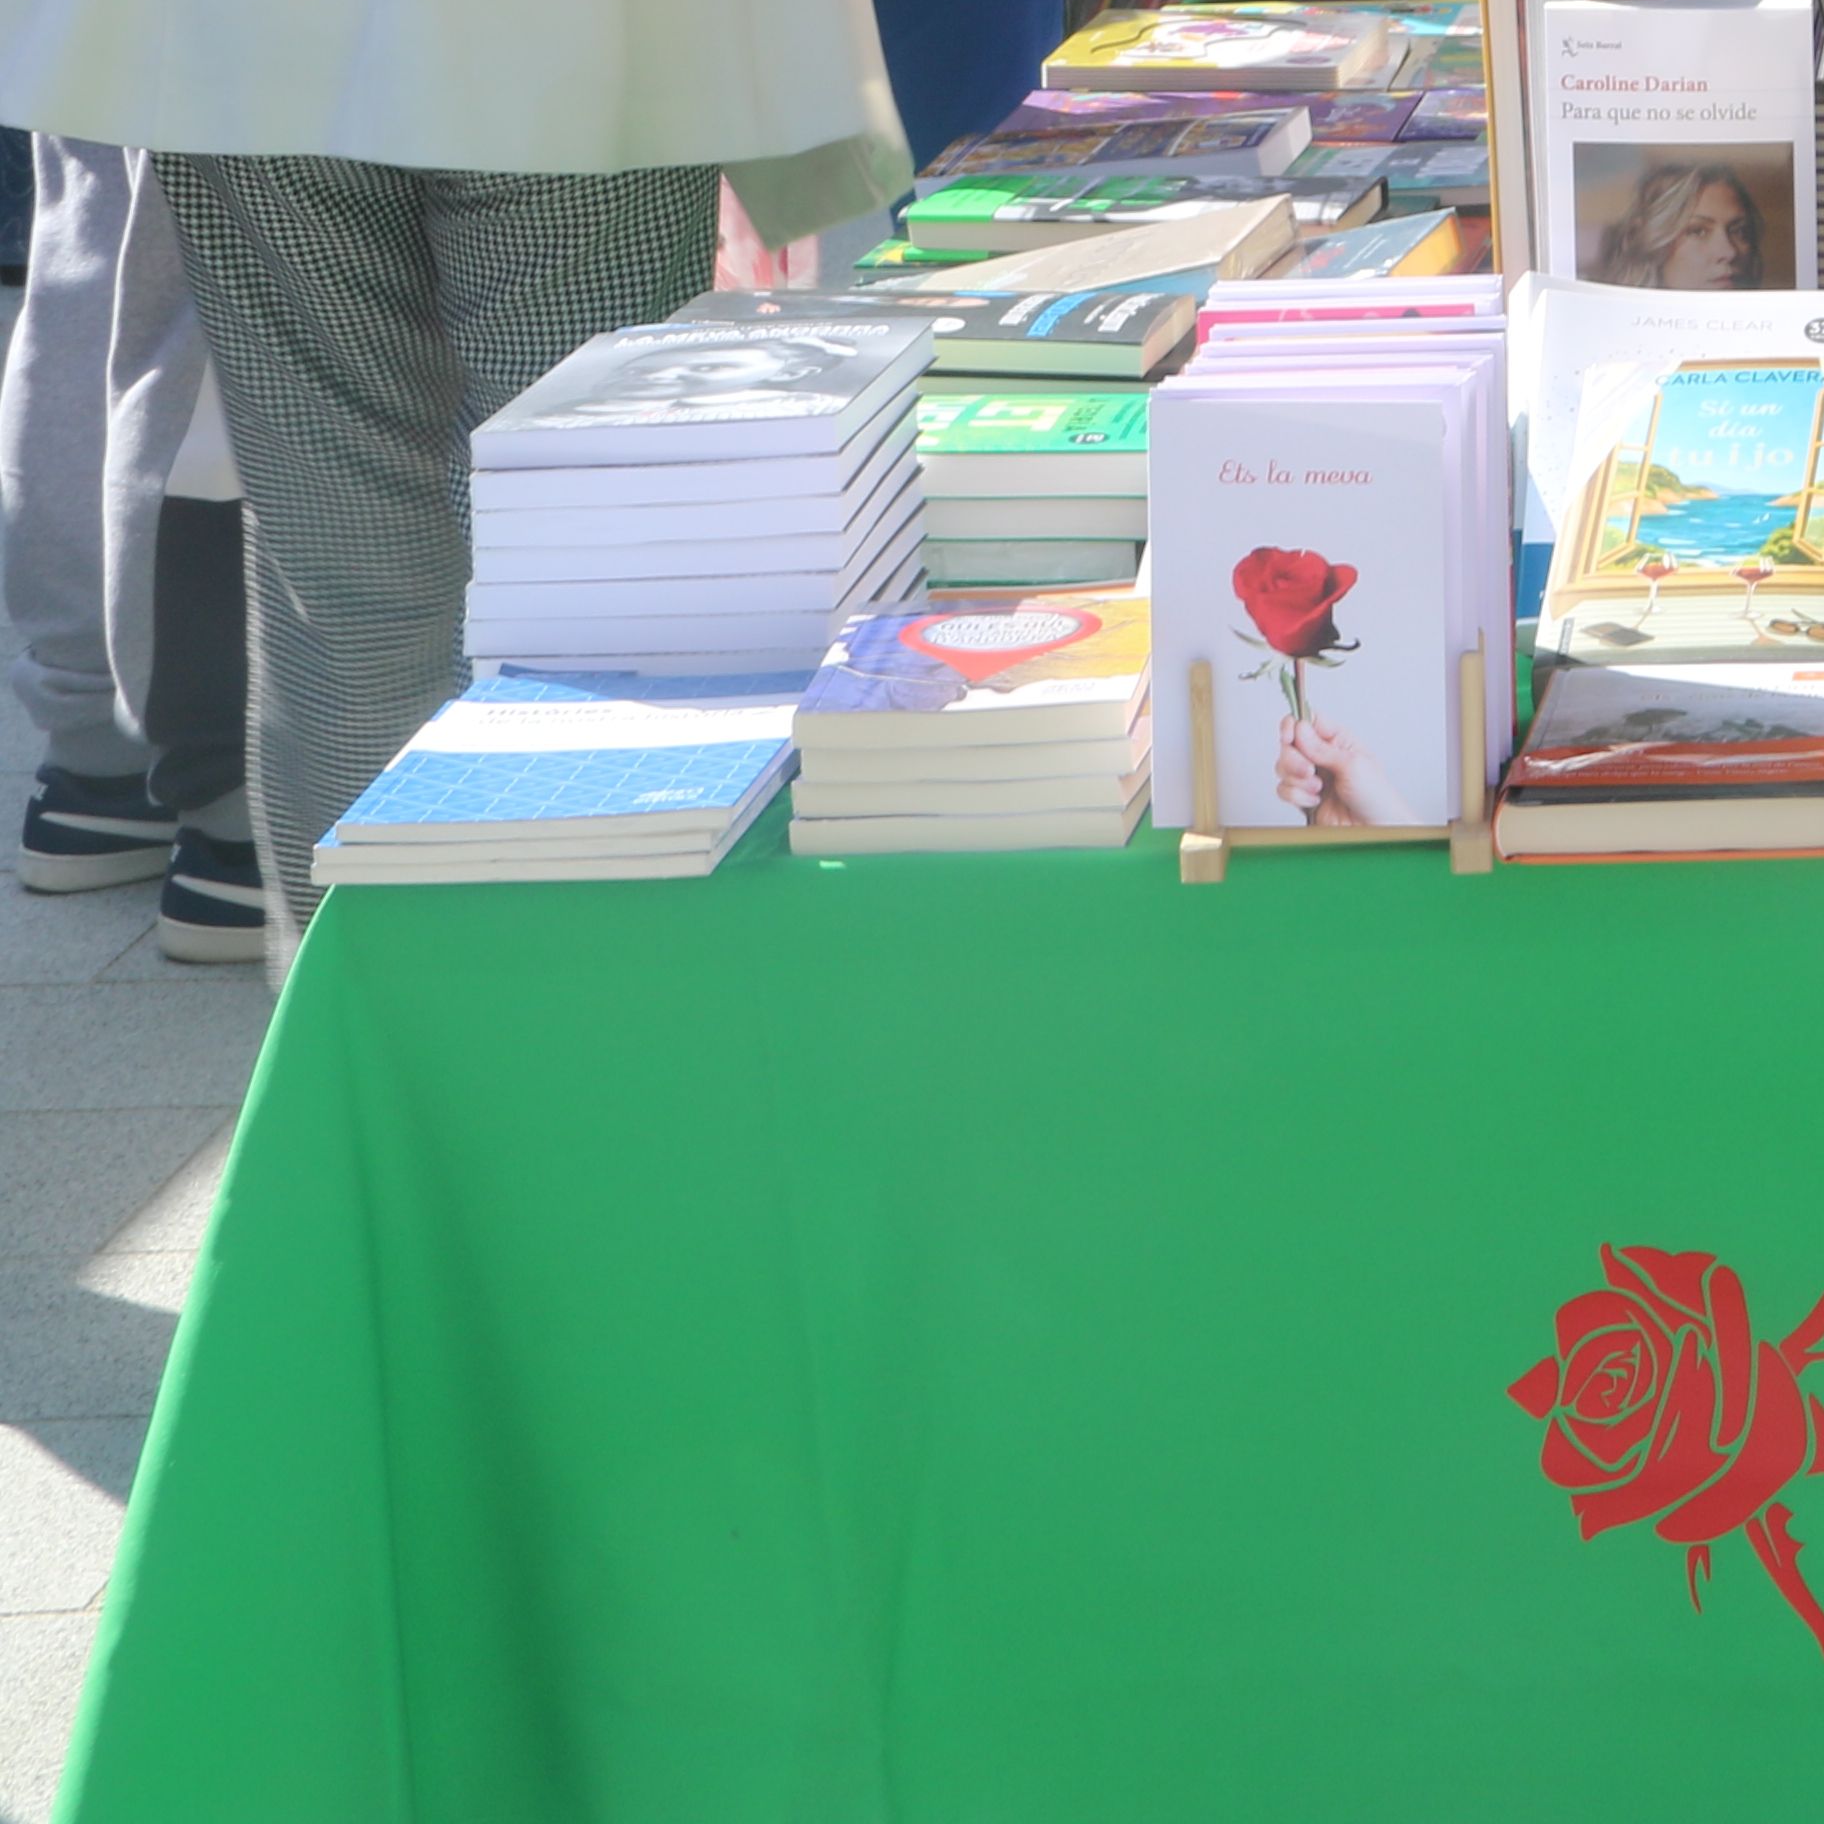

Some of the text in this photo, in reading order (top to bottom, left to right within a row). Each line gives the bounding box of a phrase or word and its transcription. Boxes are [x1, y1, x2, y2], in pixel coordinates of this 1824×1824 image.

[1561, 74, 1708, 92] Caroline Darian
[1561, 102, 1757, 125] Para que no se olvide
[1630, 316, 1774, 332] JAMES CLEAR
[1655, 372, 1726, 387] CARLA
[1698, 399, 1784, 416] Si un
[1669, 446, 1713, 467] tu
[1745, 443, 1795, 472] jo
[1218, 459, 1374, 486] Ets la meva
